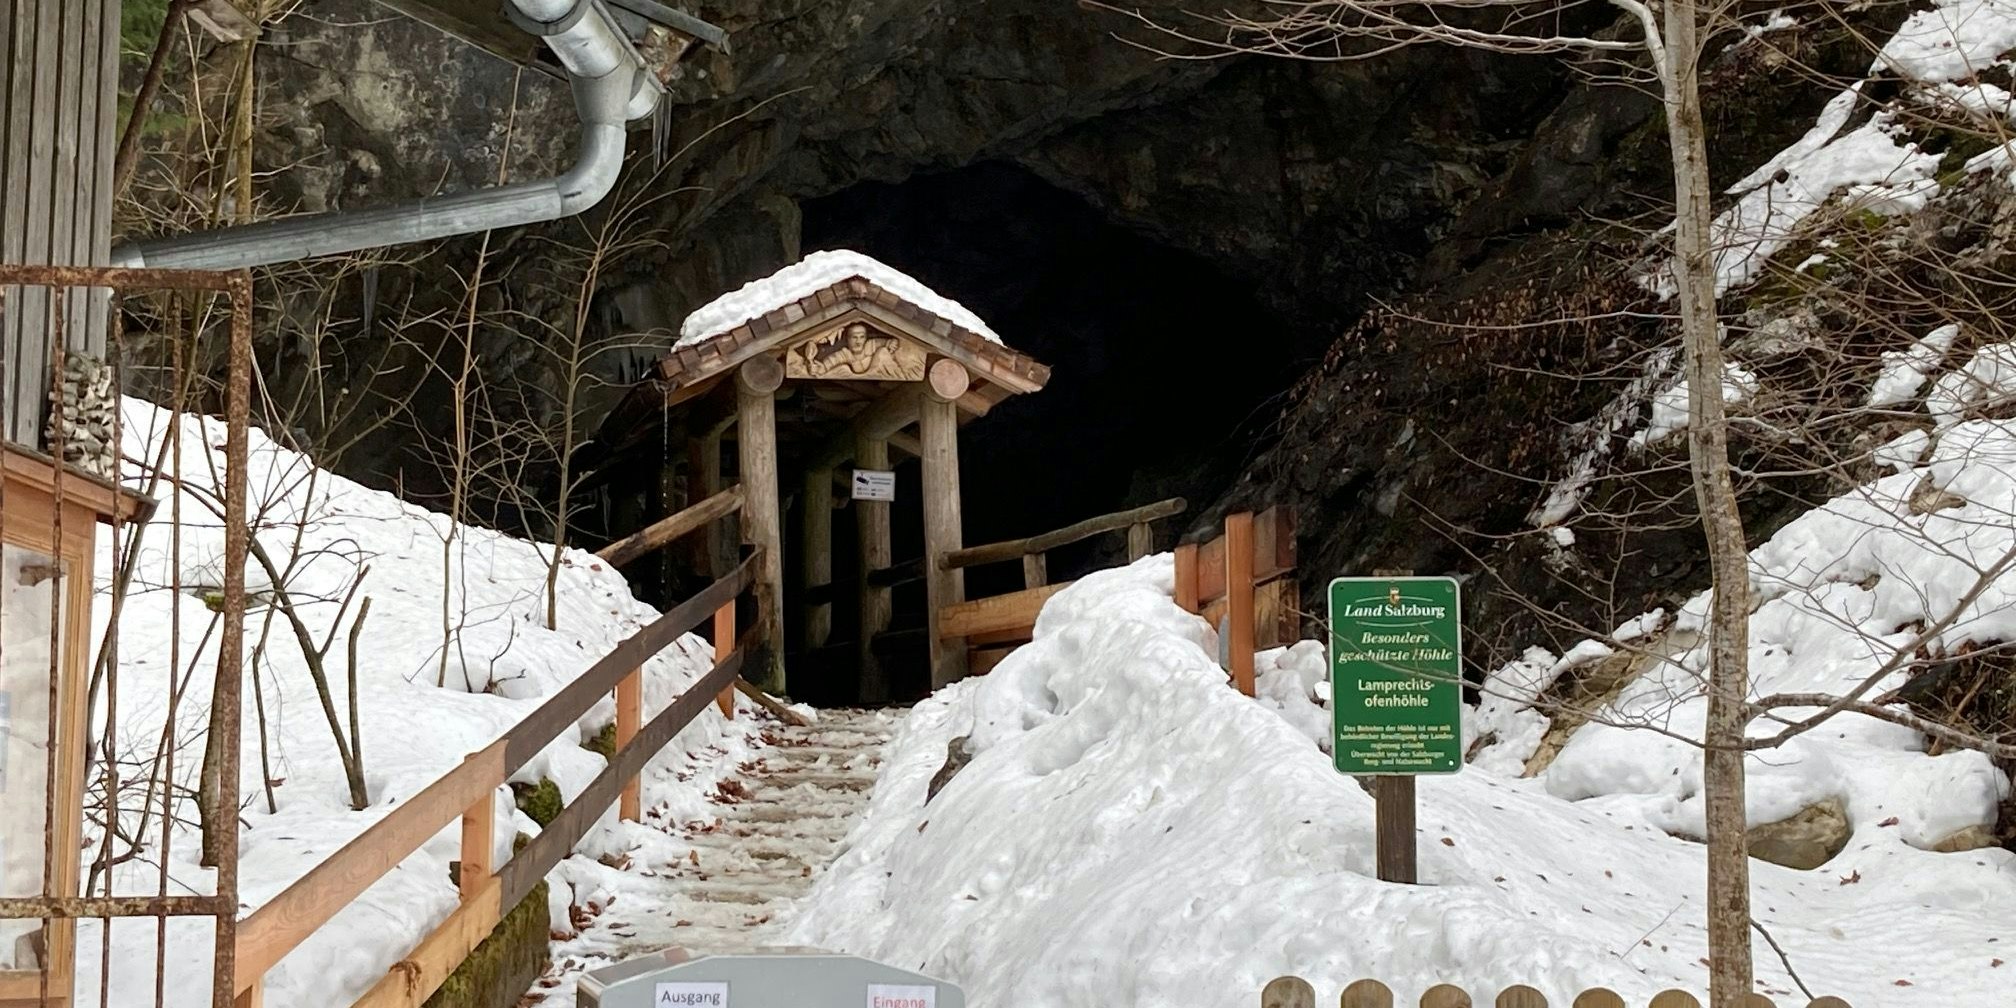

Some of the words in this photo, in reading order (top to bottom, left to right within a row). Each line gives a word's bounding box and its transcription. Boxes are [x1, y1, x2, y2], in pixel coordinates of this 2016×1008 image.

[1344, 604, 1383, 617] Land
[1385, 604, 1445, 619] Salzburg
[1361, 632, 1430, 644] Besonders
[1338, 649, 1410, 664] geschützte
[1411, 648, 1453, 661] Höhle
[1358, 678, 1435, 694] Lamprechts-
[1364, 694, 1429, 708] ofenhöhle
[661, 989, 721, 1006] Ausgang
[873, 996, 926, 1008] Eingang
